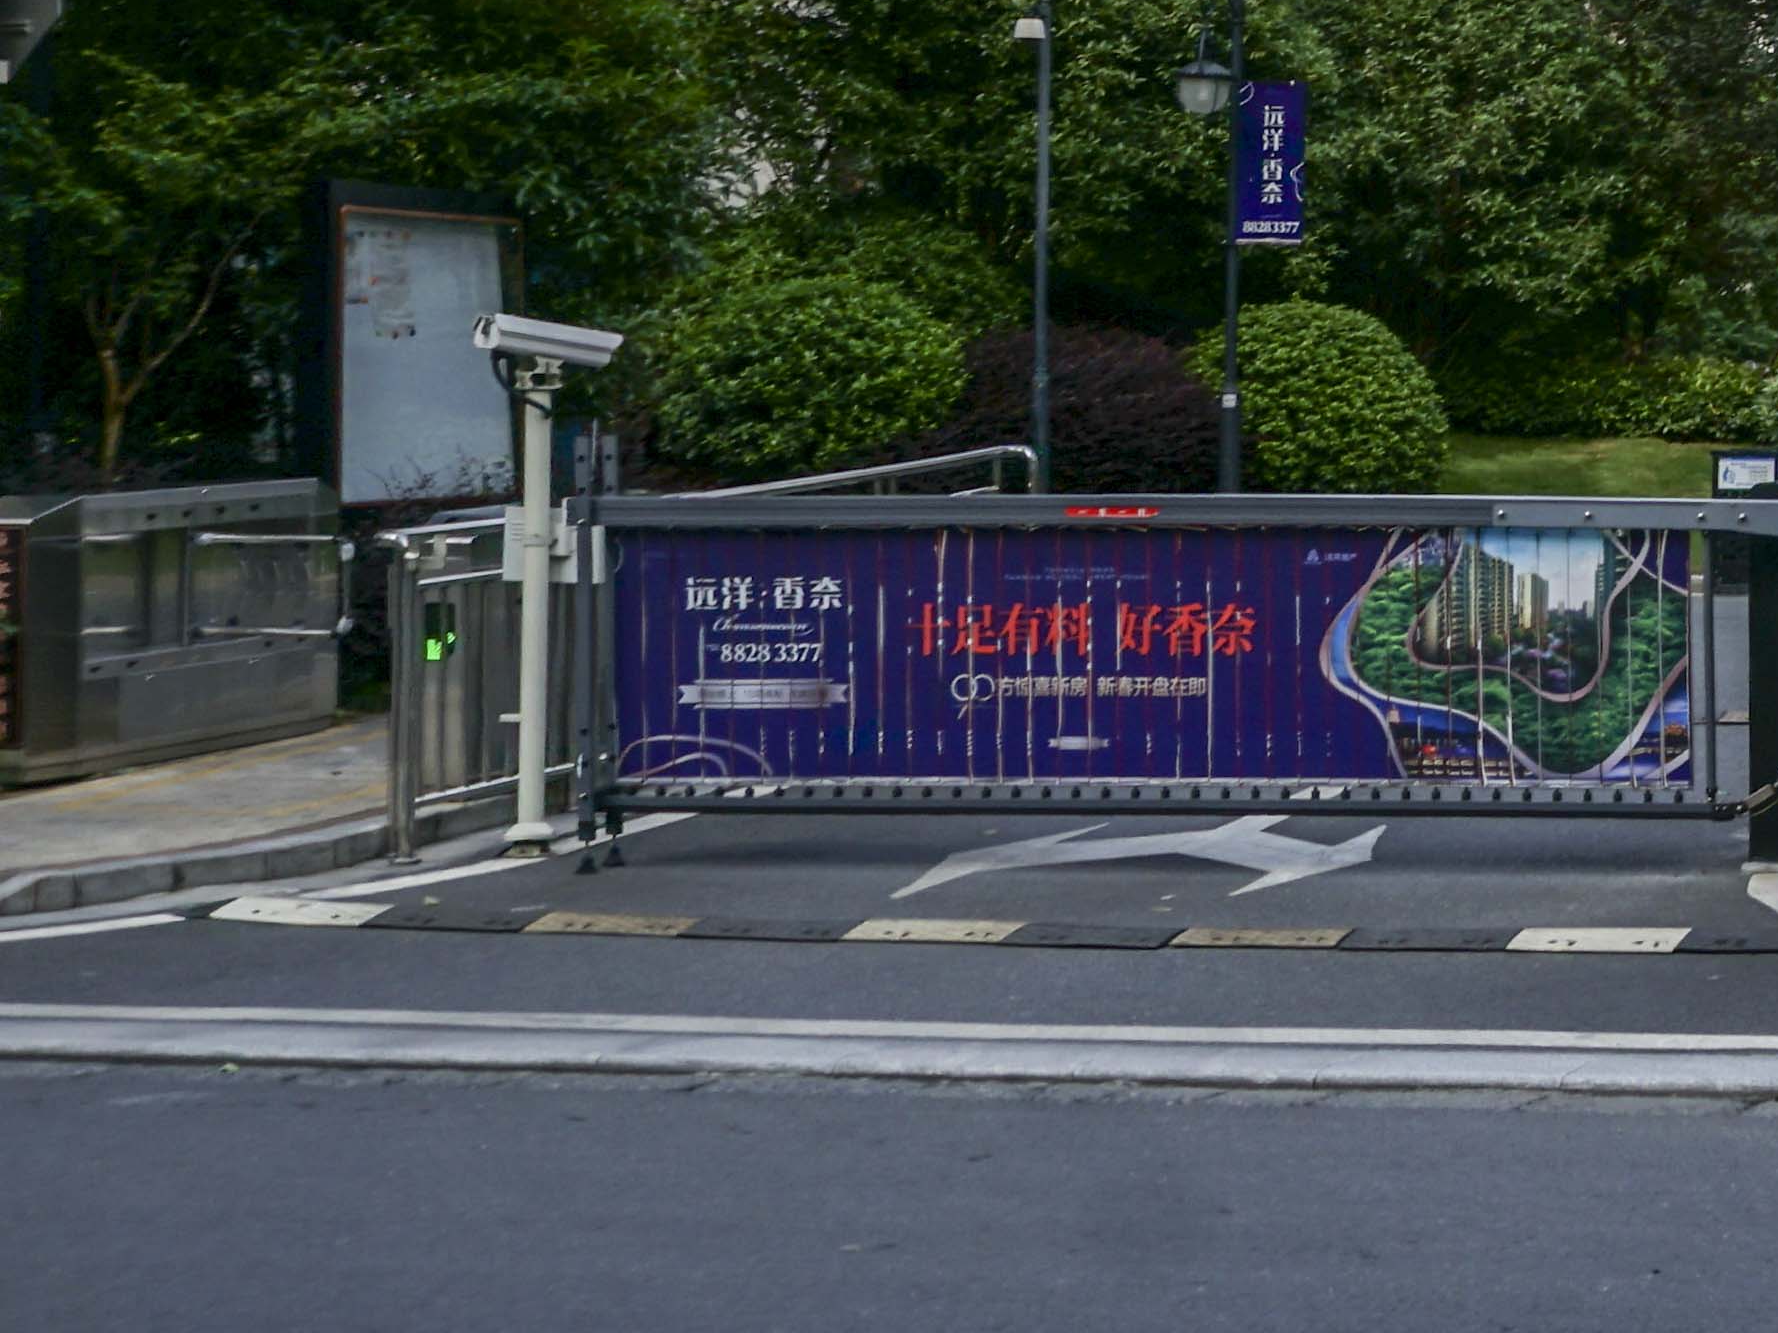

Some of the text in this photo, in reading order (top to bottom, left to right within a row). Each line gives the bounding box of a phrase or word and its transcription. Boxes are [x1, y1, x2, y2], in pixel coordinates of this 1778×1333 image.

[1260, 104, 1285, 204] 远洋·香奈
[686, 576, 843, 611] 远洋·香奈
[905, 602, 1257, 657] 十足有料 好香奈
[720, 643, 770, 662] 8828
[774, 643, 822, 662] 3377
